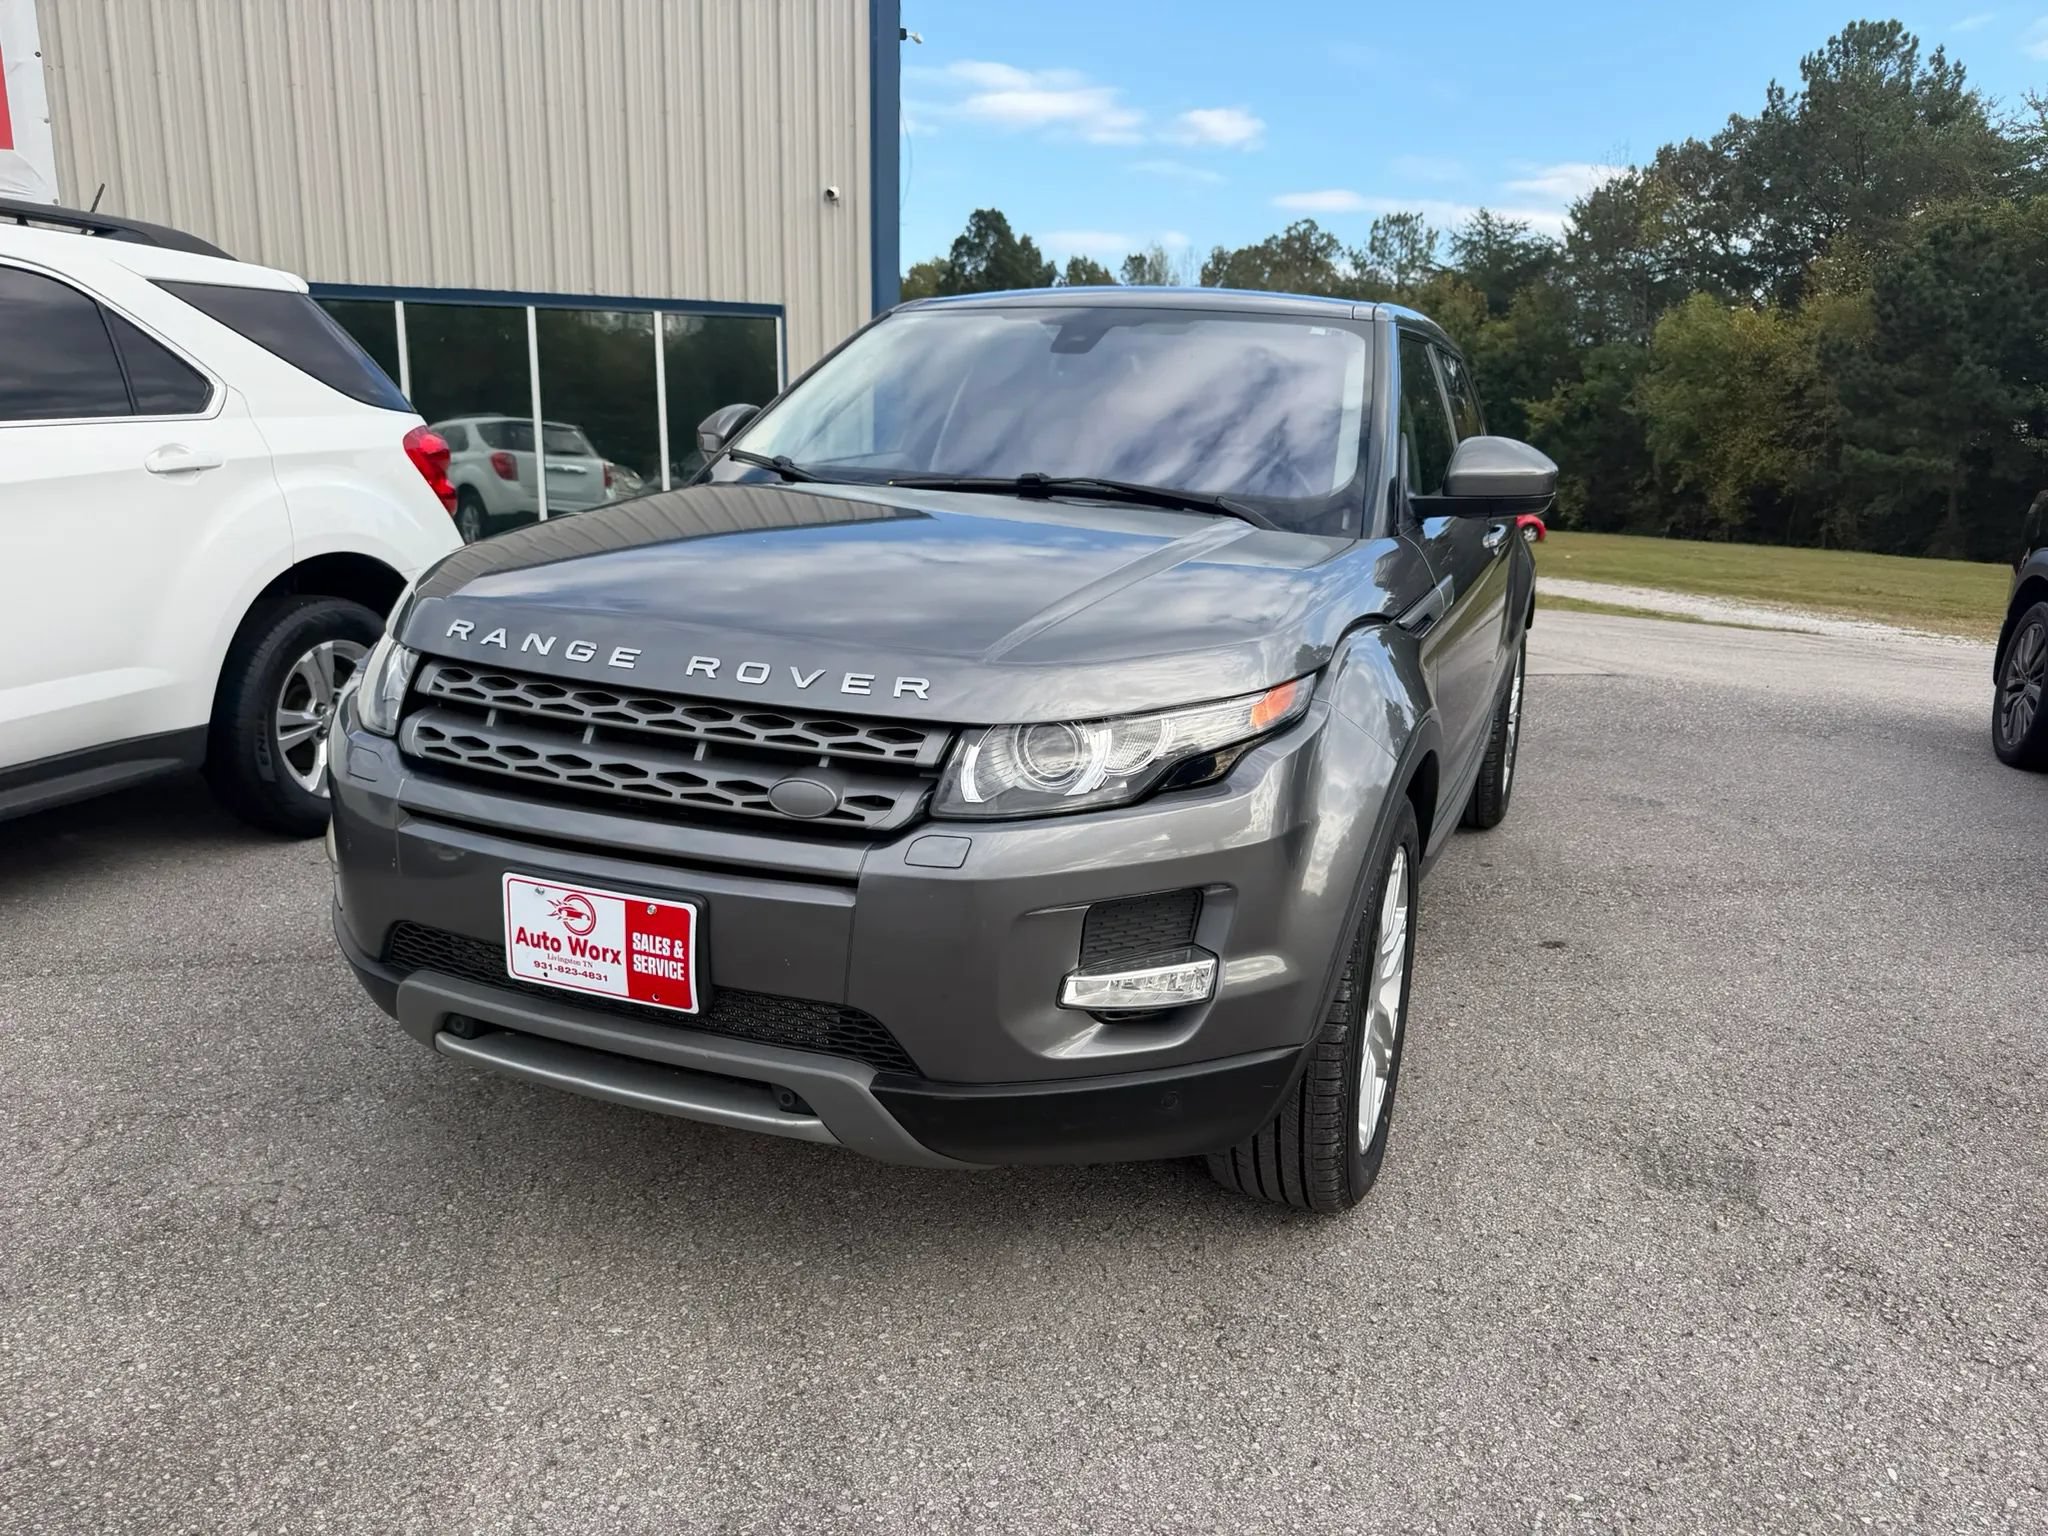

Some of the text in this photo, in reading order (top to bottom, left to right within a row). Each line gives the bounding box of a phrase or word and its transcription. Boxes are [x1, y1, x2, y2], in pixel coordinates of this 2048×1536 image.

[446, 618, 930, 700] RANGE ROVER
[515, 927, 622, 965] Auto Worx
[632, 932, 684, 959] SALES &
[533, 960, 608, 982] 931-823-4831
[582, 960, 593, 968] TN
[633, 953, 685, 981] SERVICE
